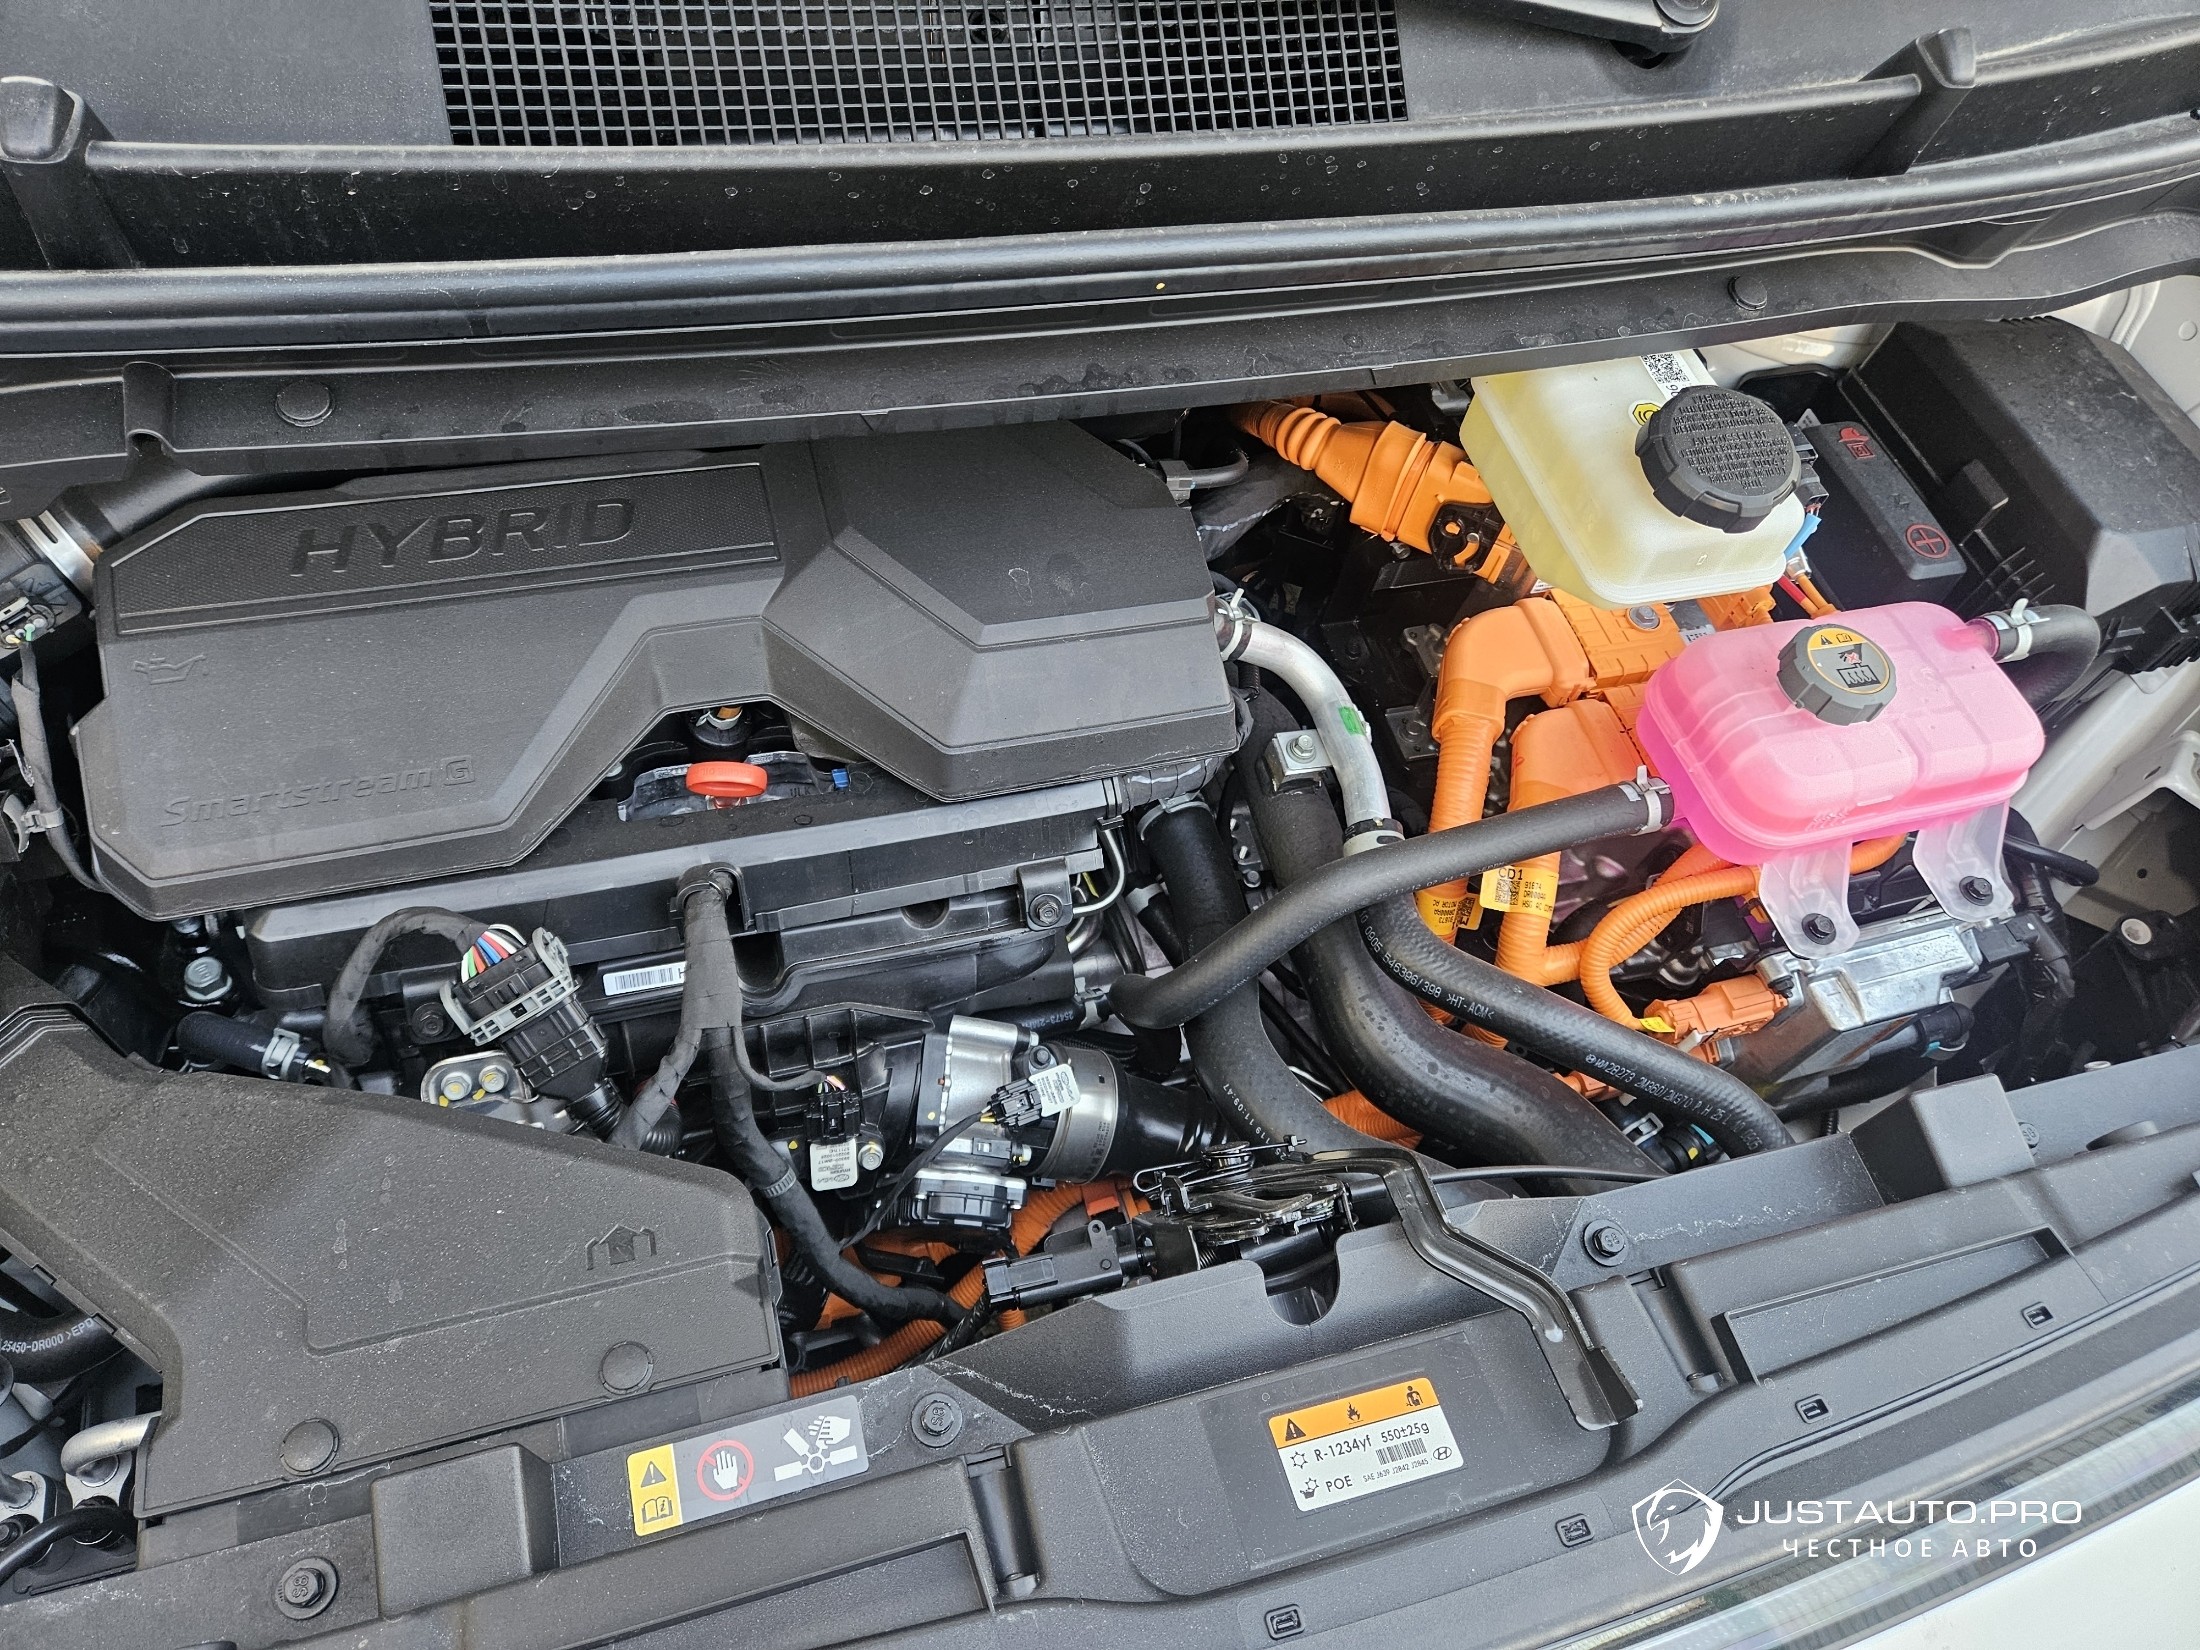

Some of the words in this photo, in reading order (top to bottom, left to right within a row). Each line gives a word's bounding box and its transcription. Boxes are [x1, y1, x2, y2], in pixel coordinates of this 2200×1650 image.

[289, 498, 636, 577] HYBRID
[160, 767, 432, 827] Smartstream
[1498, 868, 1523, 881] CD1
[1365, 926, 1383, 953] 0905
[1223, 1083, 1254, 1126] 11:09:47
[1313, 1434, 1372, 1462] R-1234yf
[1381, 1422, 1430, 1443] 550±25g
[1325, 1475, 1353, 1492] POE
[1362, 1474, 1375, 1483] SAE
[1392, 1464, 1410, 1475] J2842
